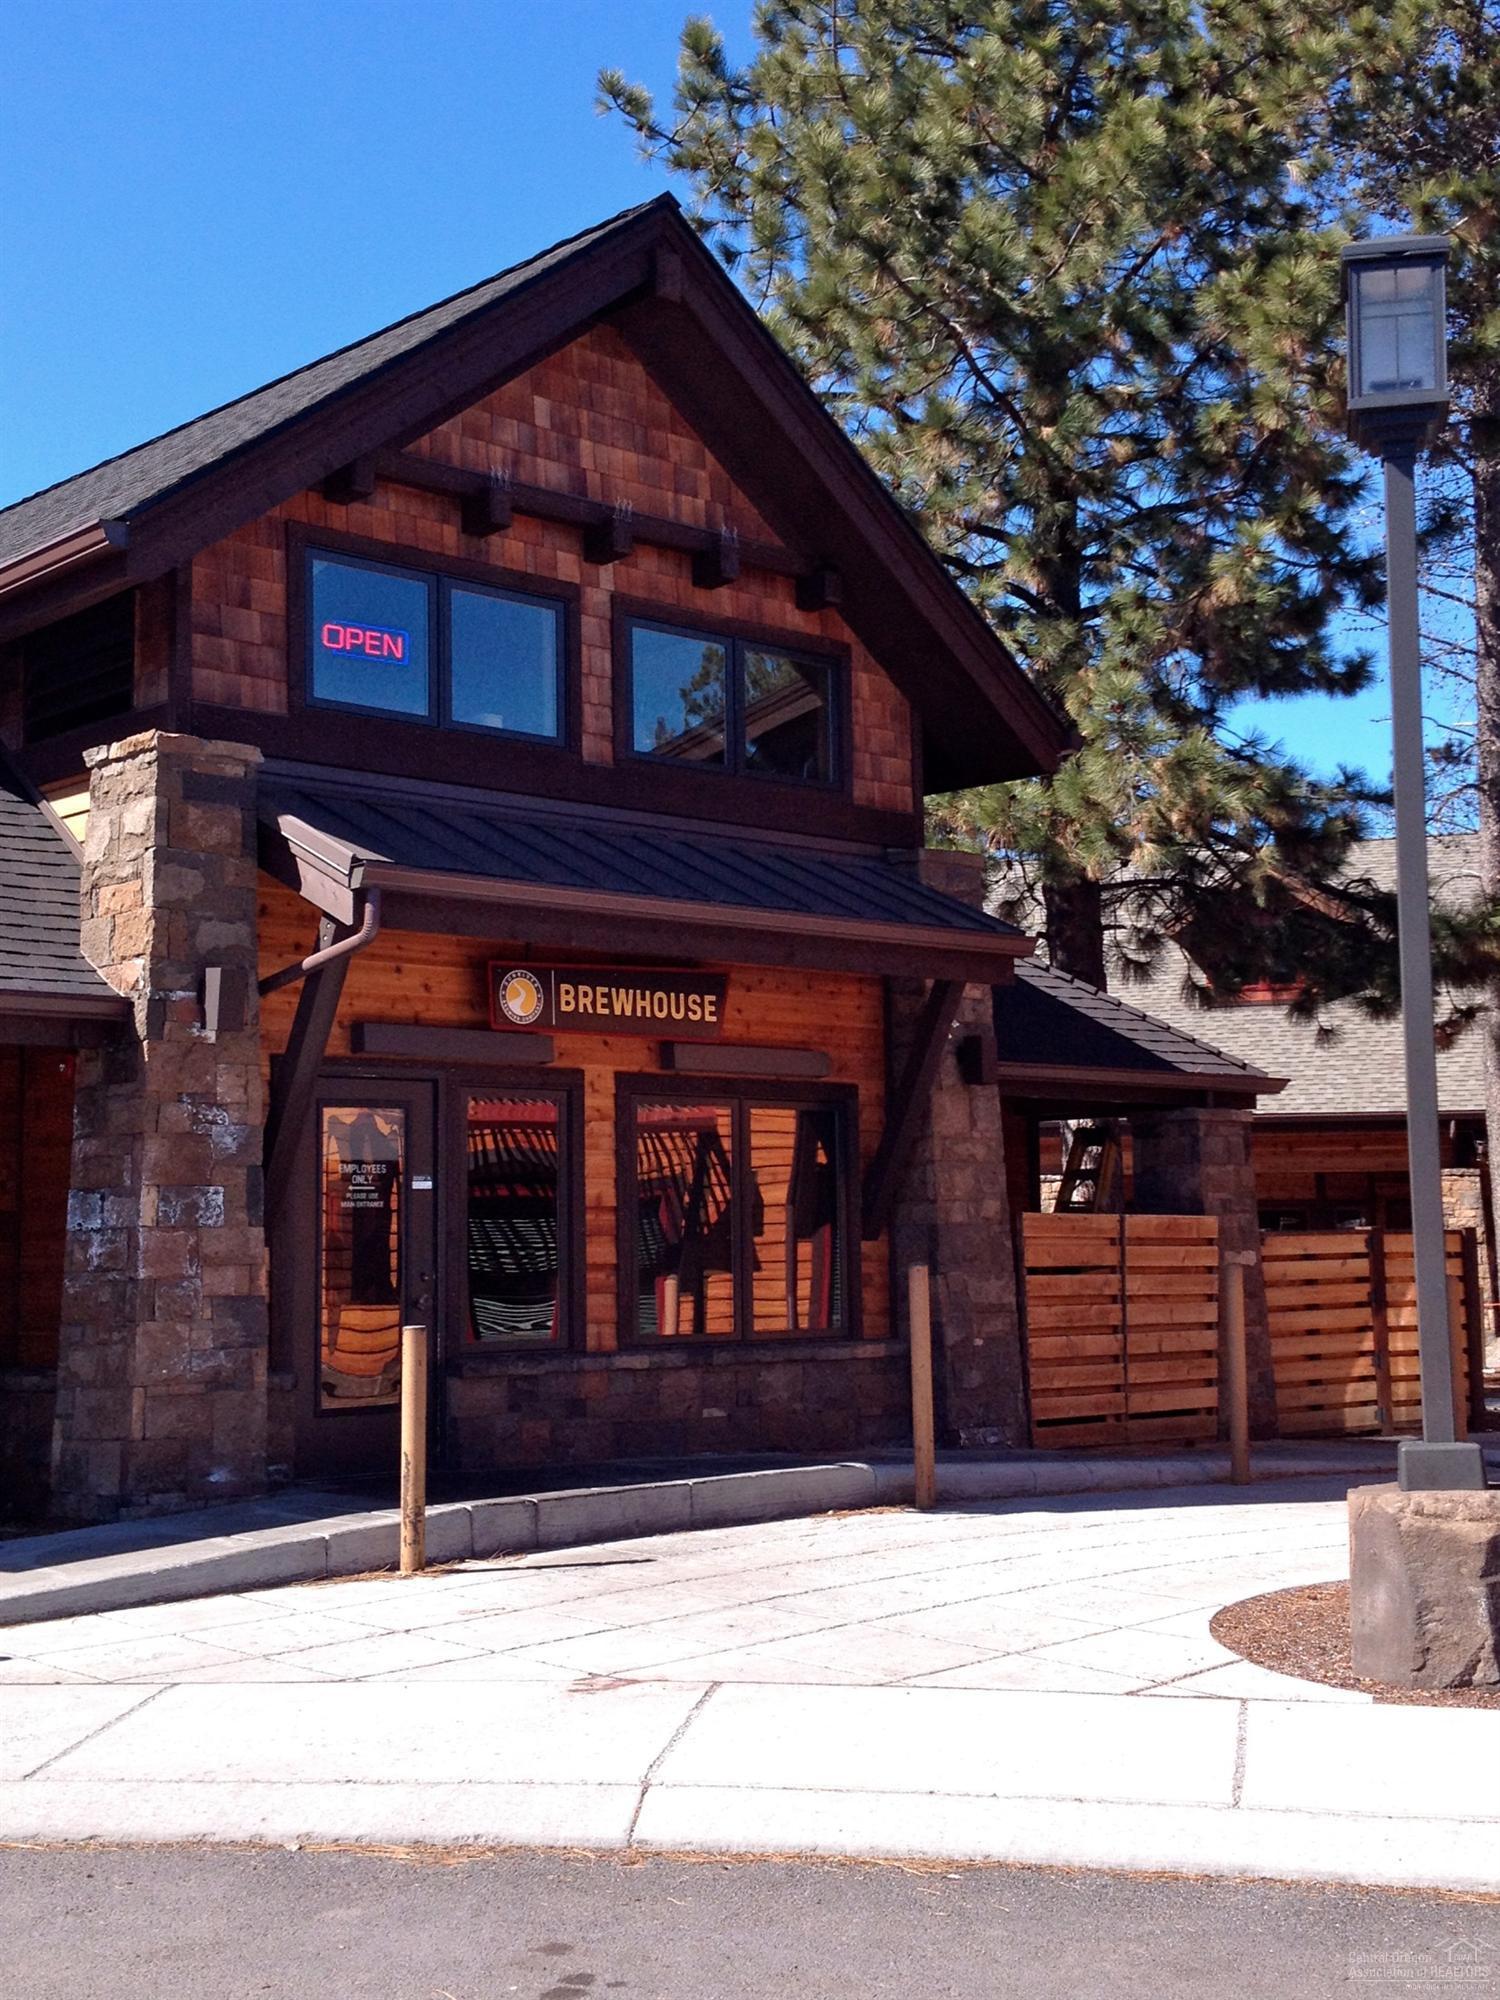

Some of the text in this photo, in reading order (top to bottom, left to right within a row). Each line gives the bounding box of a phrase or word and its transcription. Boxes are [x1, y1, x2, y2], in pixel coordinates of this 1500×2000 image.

[322, 623, 404, 659] OPEN
[560, 983, 718, 1023] BREWHOUSE
[338, 1163, 387, 1174] EMPLOYEES
[351, 1174, 373, 1184] ONLY
